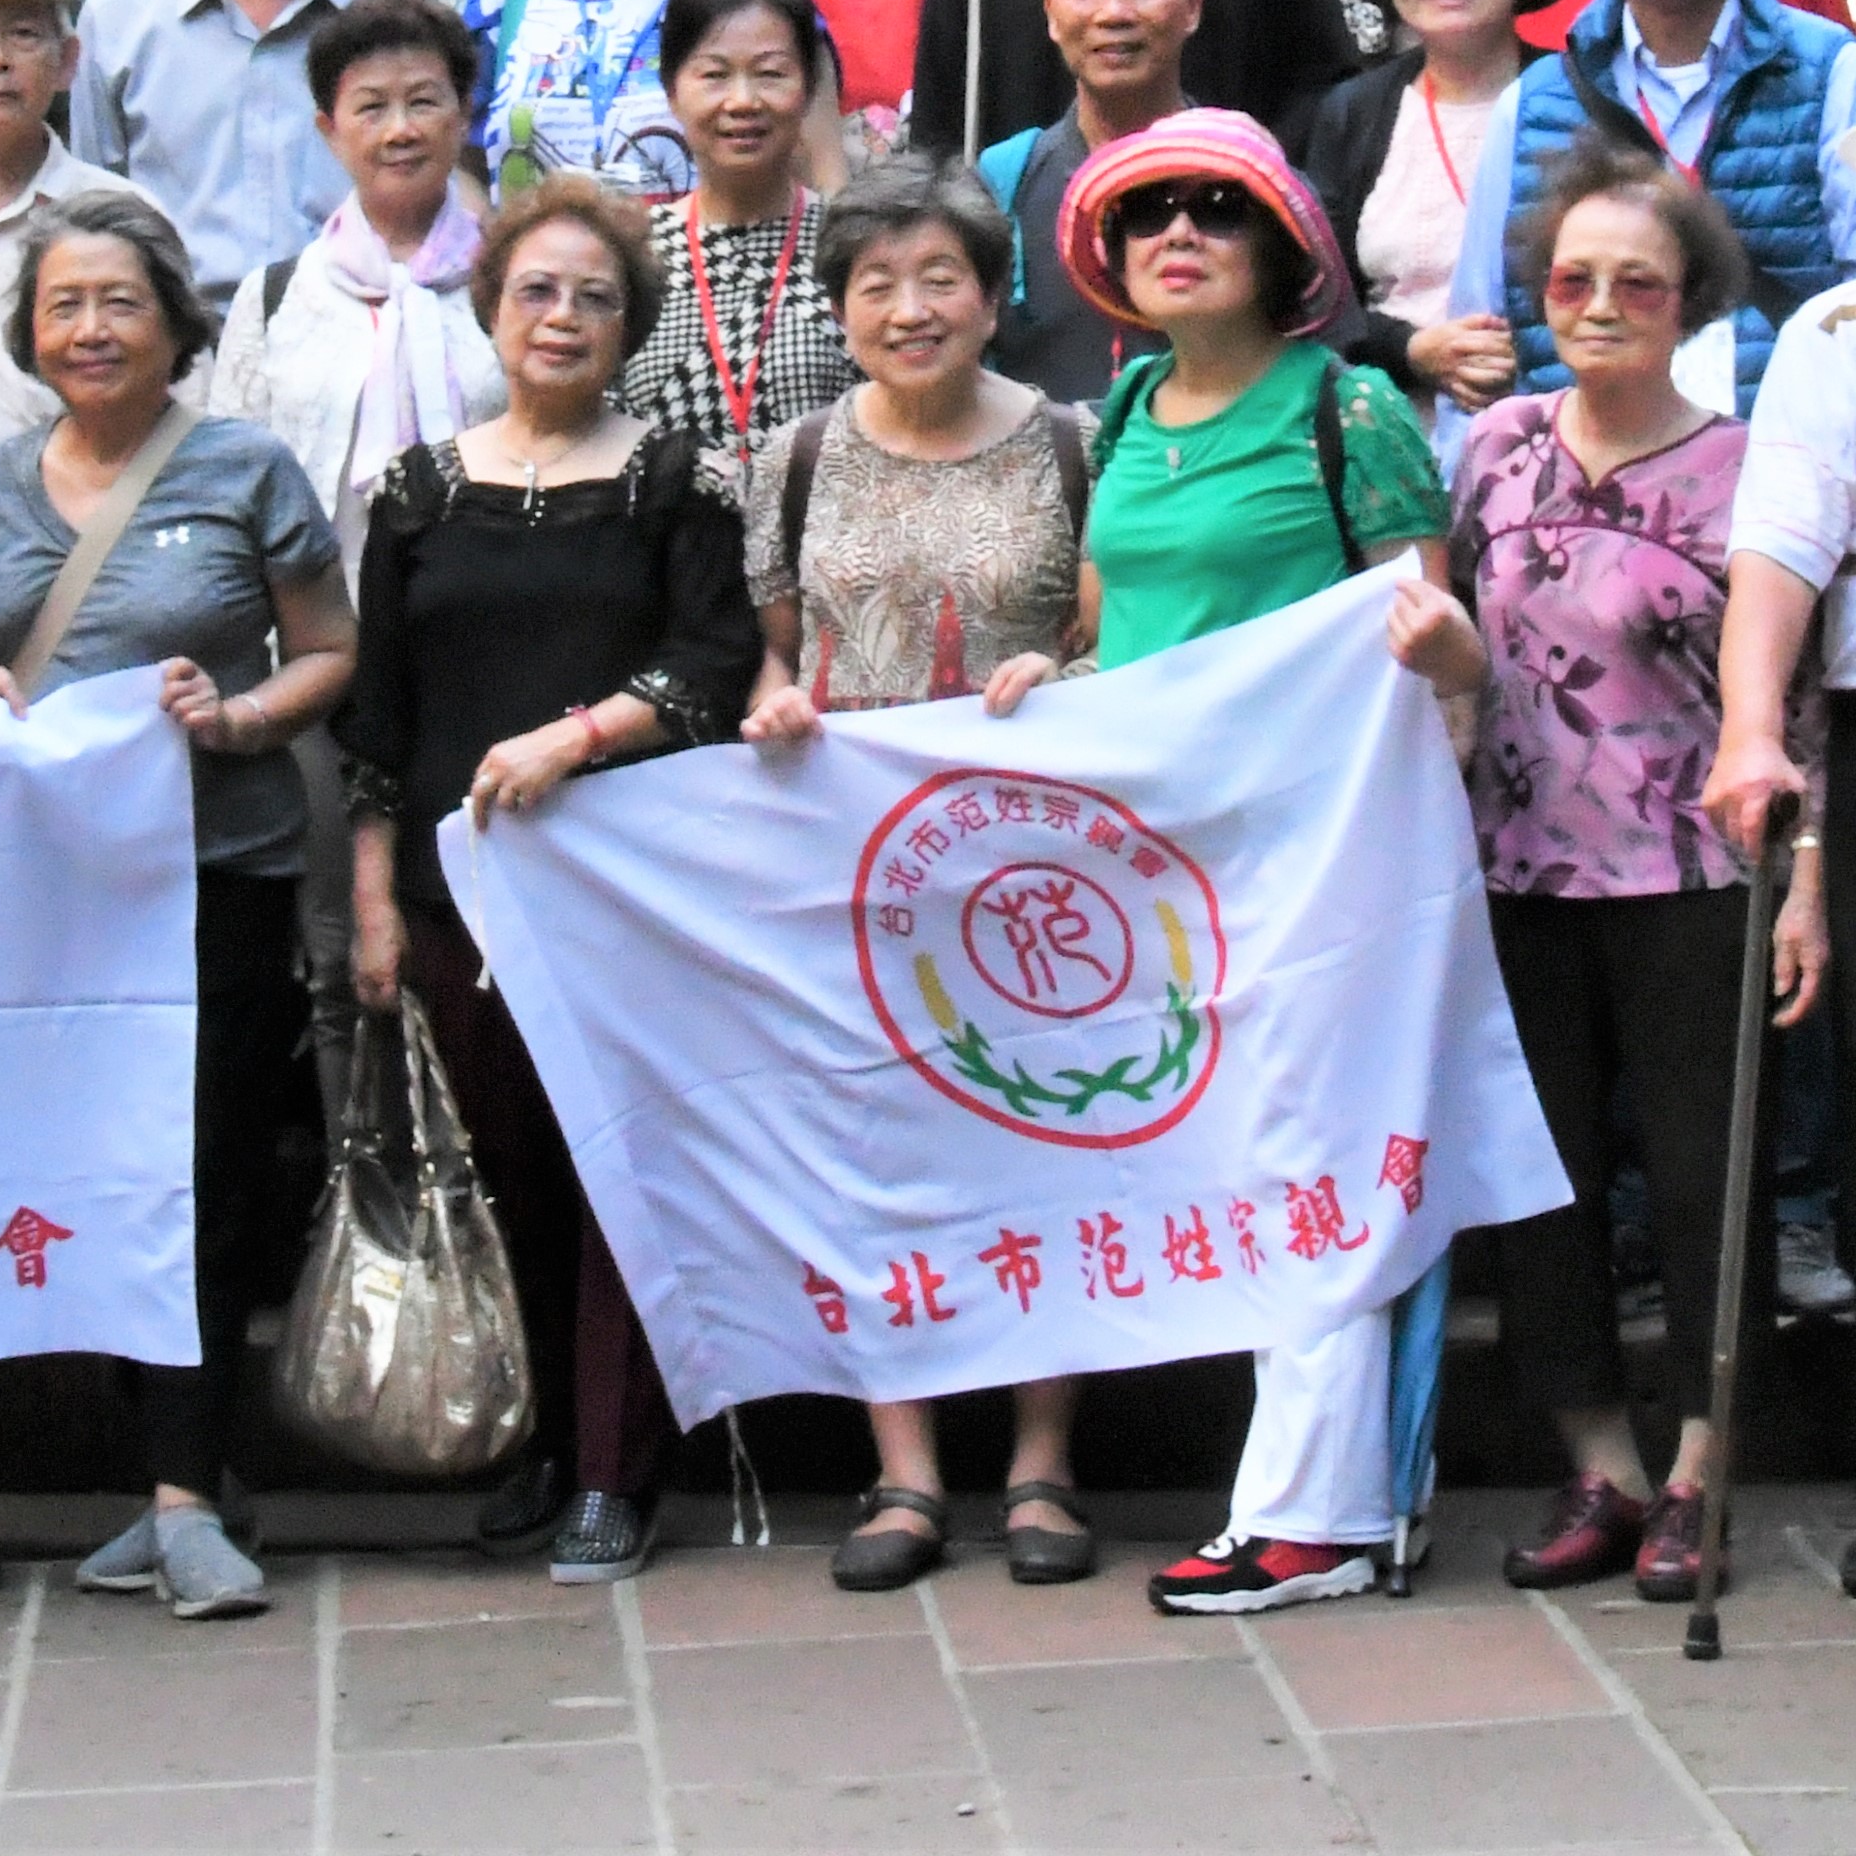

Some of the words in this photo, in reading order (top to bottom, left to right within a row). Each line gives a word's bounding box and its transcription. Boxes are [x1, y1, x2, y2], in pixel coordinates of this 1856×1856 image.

[880, 786, 1168, 937] 台北市范姓宗親會
[804, 1132, 1429, 1334] 台北市范姓宗親會
